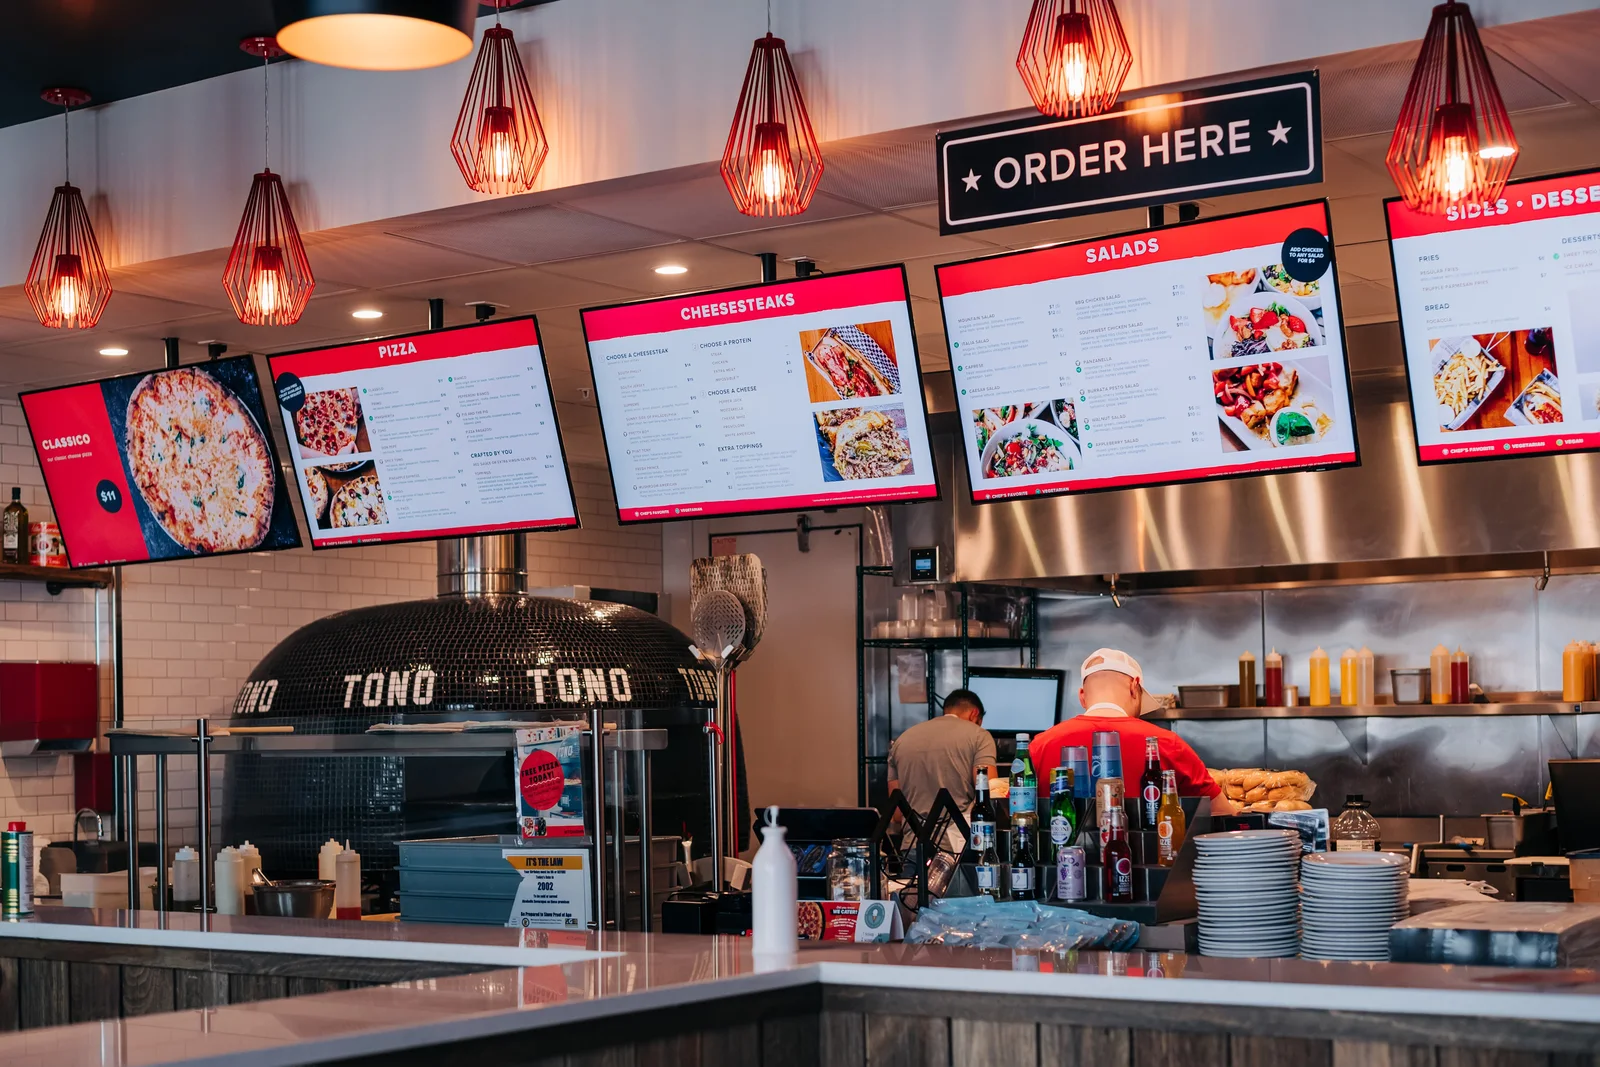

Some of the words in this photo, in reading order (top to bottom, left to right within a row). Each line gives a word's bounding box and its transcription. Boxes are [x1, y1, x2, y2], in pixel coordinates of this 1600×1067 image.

[994, 140, 1127, 190] ORDER
[1143, 118, 1251, 168] HERE
[1085, 238, 1160, 264] SALADS
[1418, 254, 1440, 262] FRIES
[680, 293, 795, 321] CHEESESTEAKS
[1424, 303, 1450, 312] BREAD
[378, 342, 417, 358] PIZZA
[700, 341, 722, 349] CHOOSE
[633, 348, 669, 358] CHEESESTEAK
[42, 434, 90, 450] CLASSICO
[736, 442, 763, 450] TOPPINGS
[100, 490, 116, 503] $11
[343, 670, 436, 708] TONO
[526, 668, 632, 704] TONO
[521, 767, 537, 778] FREE
[538, 760, 560, 772] PIZZA
[526, 858, 537, 866] IT'S
[538, 858, 549, 866] THE
[550, 858, 563, 866] LAW
[538, 882, 553, 891] 2002
